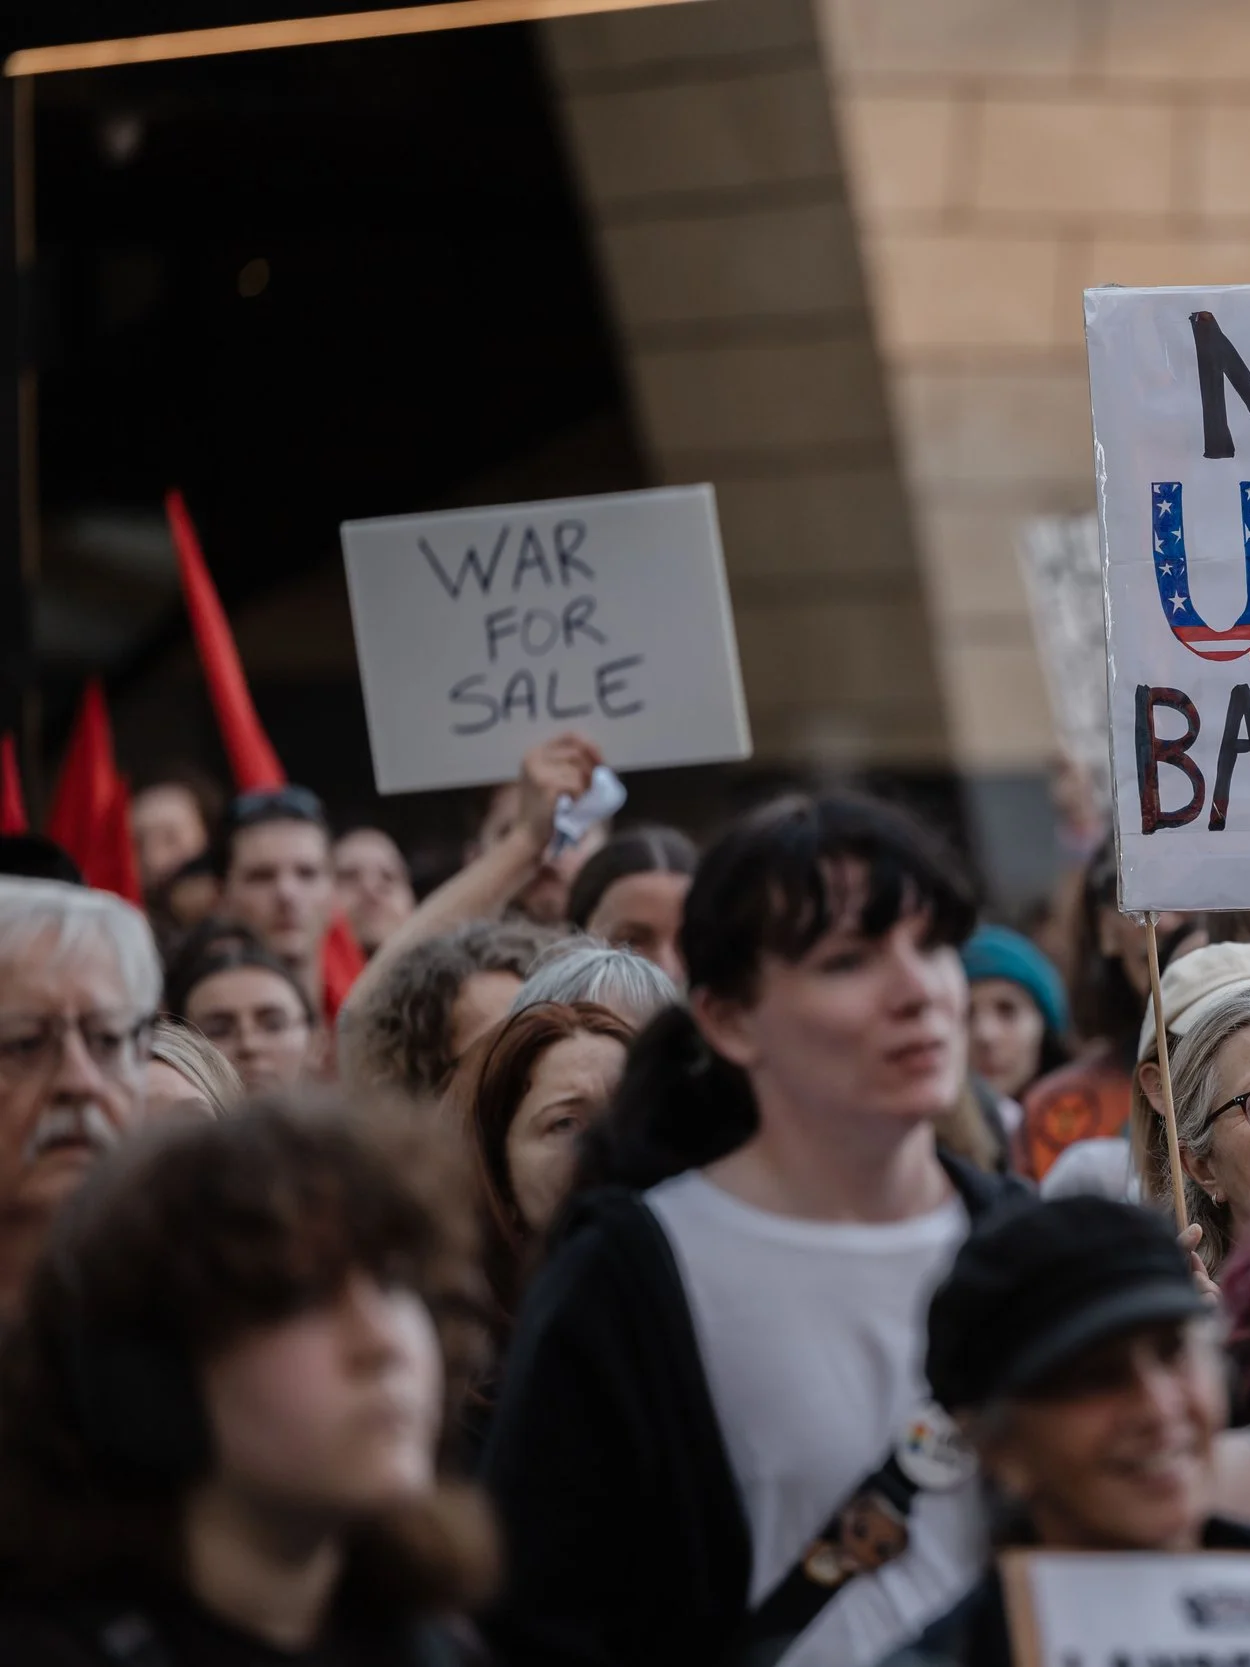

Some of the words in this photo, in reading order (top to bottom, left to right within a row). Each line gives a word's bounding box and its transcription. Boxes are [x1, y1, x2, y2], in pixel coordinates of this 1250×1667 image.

[417, 519, 596, 601] WAR
[482, 594, 607, 663] FOR
[446, 653, 646, 737] SALE
